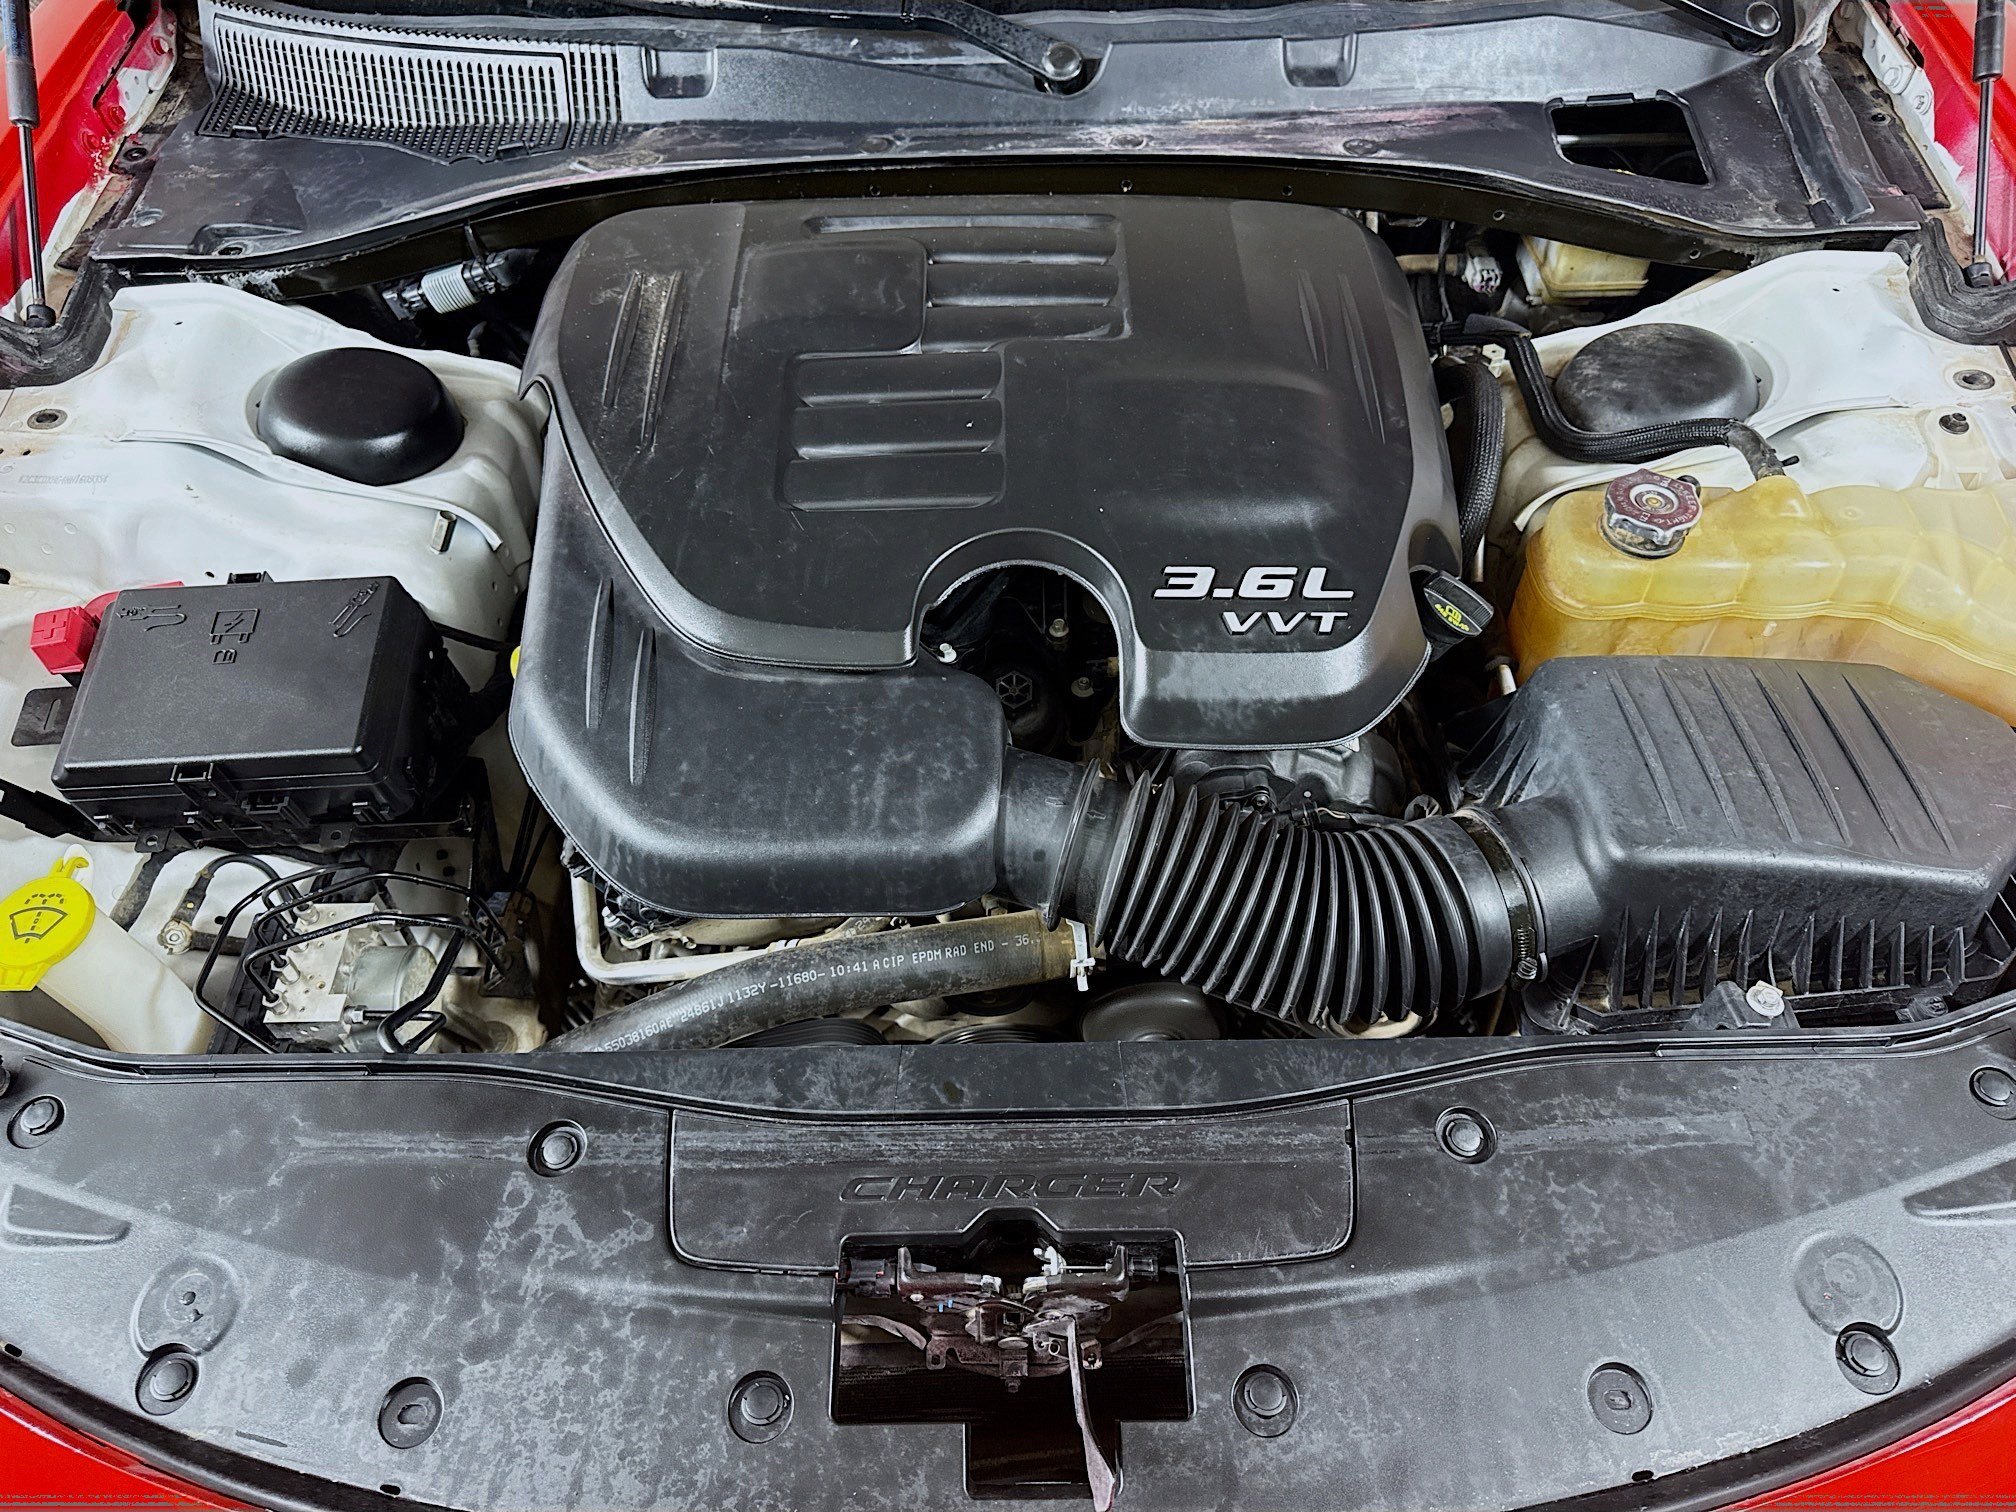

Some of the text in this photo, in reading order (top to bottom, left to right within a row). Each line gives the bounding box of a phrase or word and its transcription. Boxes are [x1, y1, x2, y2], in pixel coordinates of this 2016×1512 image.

[1153, 565, 1355, 600] 3.6L
[1221, 611, 1349, 636] VVT
[830, 961, 868, 977] 10:41
[912, 949, 942, 964] EPDM
[945, 945, 967, 959] RAD
[974, 940, 995, 954] END
[839, 1172, 1181, 1201] CHARGER
